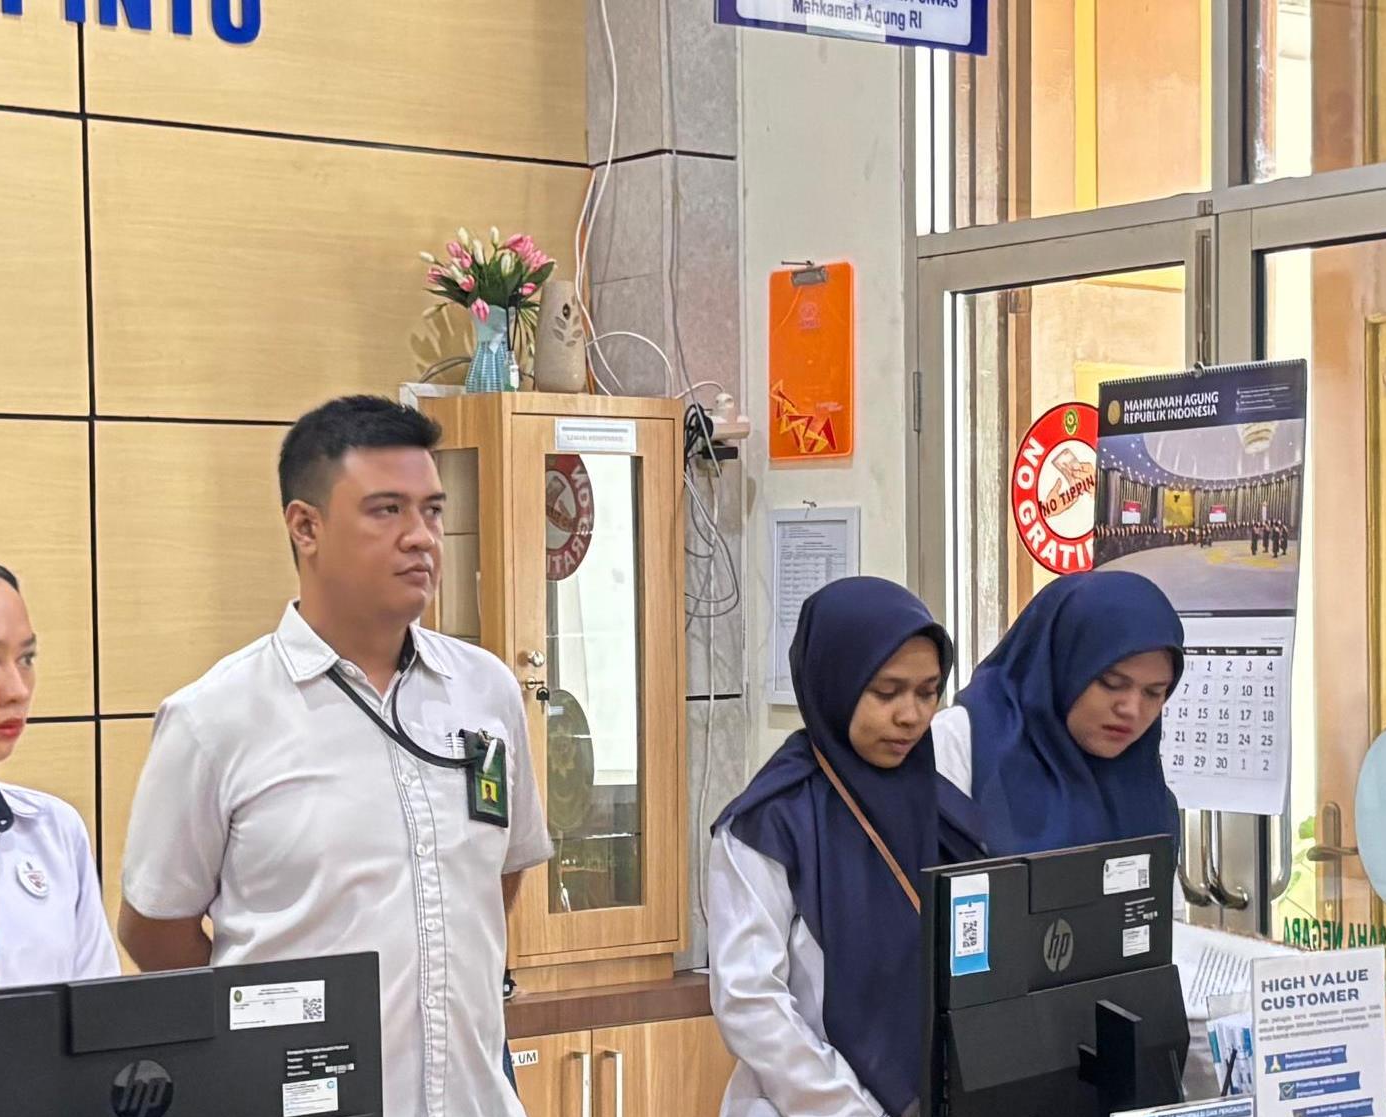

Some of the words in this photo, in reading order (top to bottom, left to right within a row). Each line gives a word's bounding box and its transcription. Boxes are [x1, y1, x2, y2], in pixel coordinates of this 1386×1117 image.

[865, 4, 906, 31] Agung
[909, 10, 922, 29] RI
[1124, 396, 1182, 412] MAHKAMAH
[1183, 391, 1219, 405] AGUNG
[1124, 408, 1166, 424] REPUBLIK
[1167, 405, 1218, 420] INDONESIA
[1059, 474, 1095, 507] TIPPIN
[1226, 661, 1232, 672] 2
[1246, 661, 1253, 672] 3
[1267, 662, 1273, 672] 4
[1184, 683, 1189, 694] 7
[1202, 684, 1208, 694] 8
[1223, 684, 1229, 695] 9
[1242, 685, 1253, 696] 10
[1264, 685, 1275, 697] 11
[1163, 706, 1169, 718] 3
[1178, 707, 1188, 719] 14
[1198, 708, 1208, 719] 15
[1219, 708, 1229, 720] 16
[1240, 709, 1252, 720] 17
[1263, 710, 1274, 722] 18
[1175, 731, 1185, 742] 21
[1195, 732, 1207, 743] 22
[1217, 733, 1229, 744] 23
[1238, 734, 1250, 745] 24
[1261, 735, 1273, 746] 25
[1173, 754, 1184, 766] 28
[1194, 756, 1206, 767] 29
[1216, 757, 1228, 769] 30
[1263, 760, 1269, 771] 2
[1045, 919, 1073, 971] hp
[1261, 974, 1305, 993] HIGH
[1309, 968, 1369, 987] VALUE
[1261, 988, 1360, 1012] CUSTOMER
